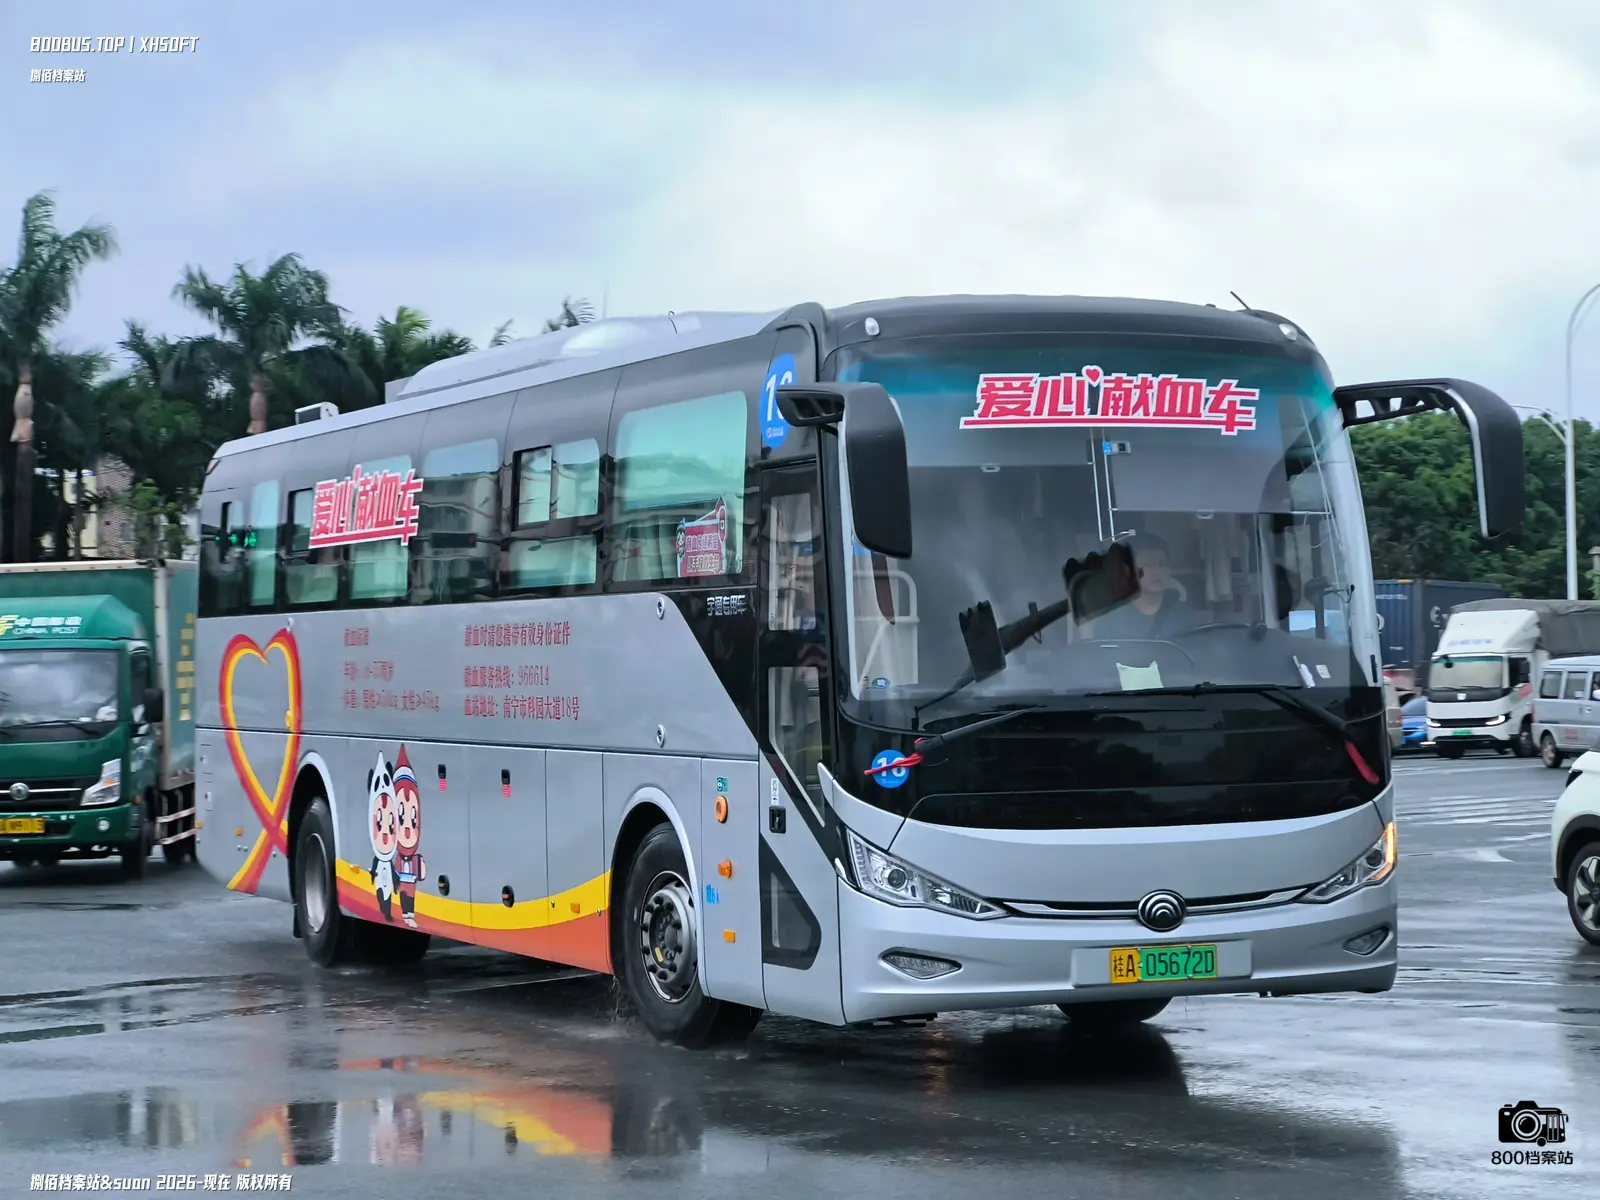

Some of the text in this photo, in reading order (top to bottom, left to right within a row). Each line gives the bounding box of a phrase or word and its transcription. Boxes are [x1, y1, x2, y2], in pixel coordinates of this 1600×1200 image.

[960, 372, 1260, 436] 爱心献血车
[309, 468, 424, 547] 爱心献血车
[464, 621, 571, 648] 献血时请您携带有效身份证件
